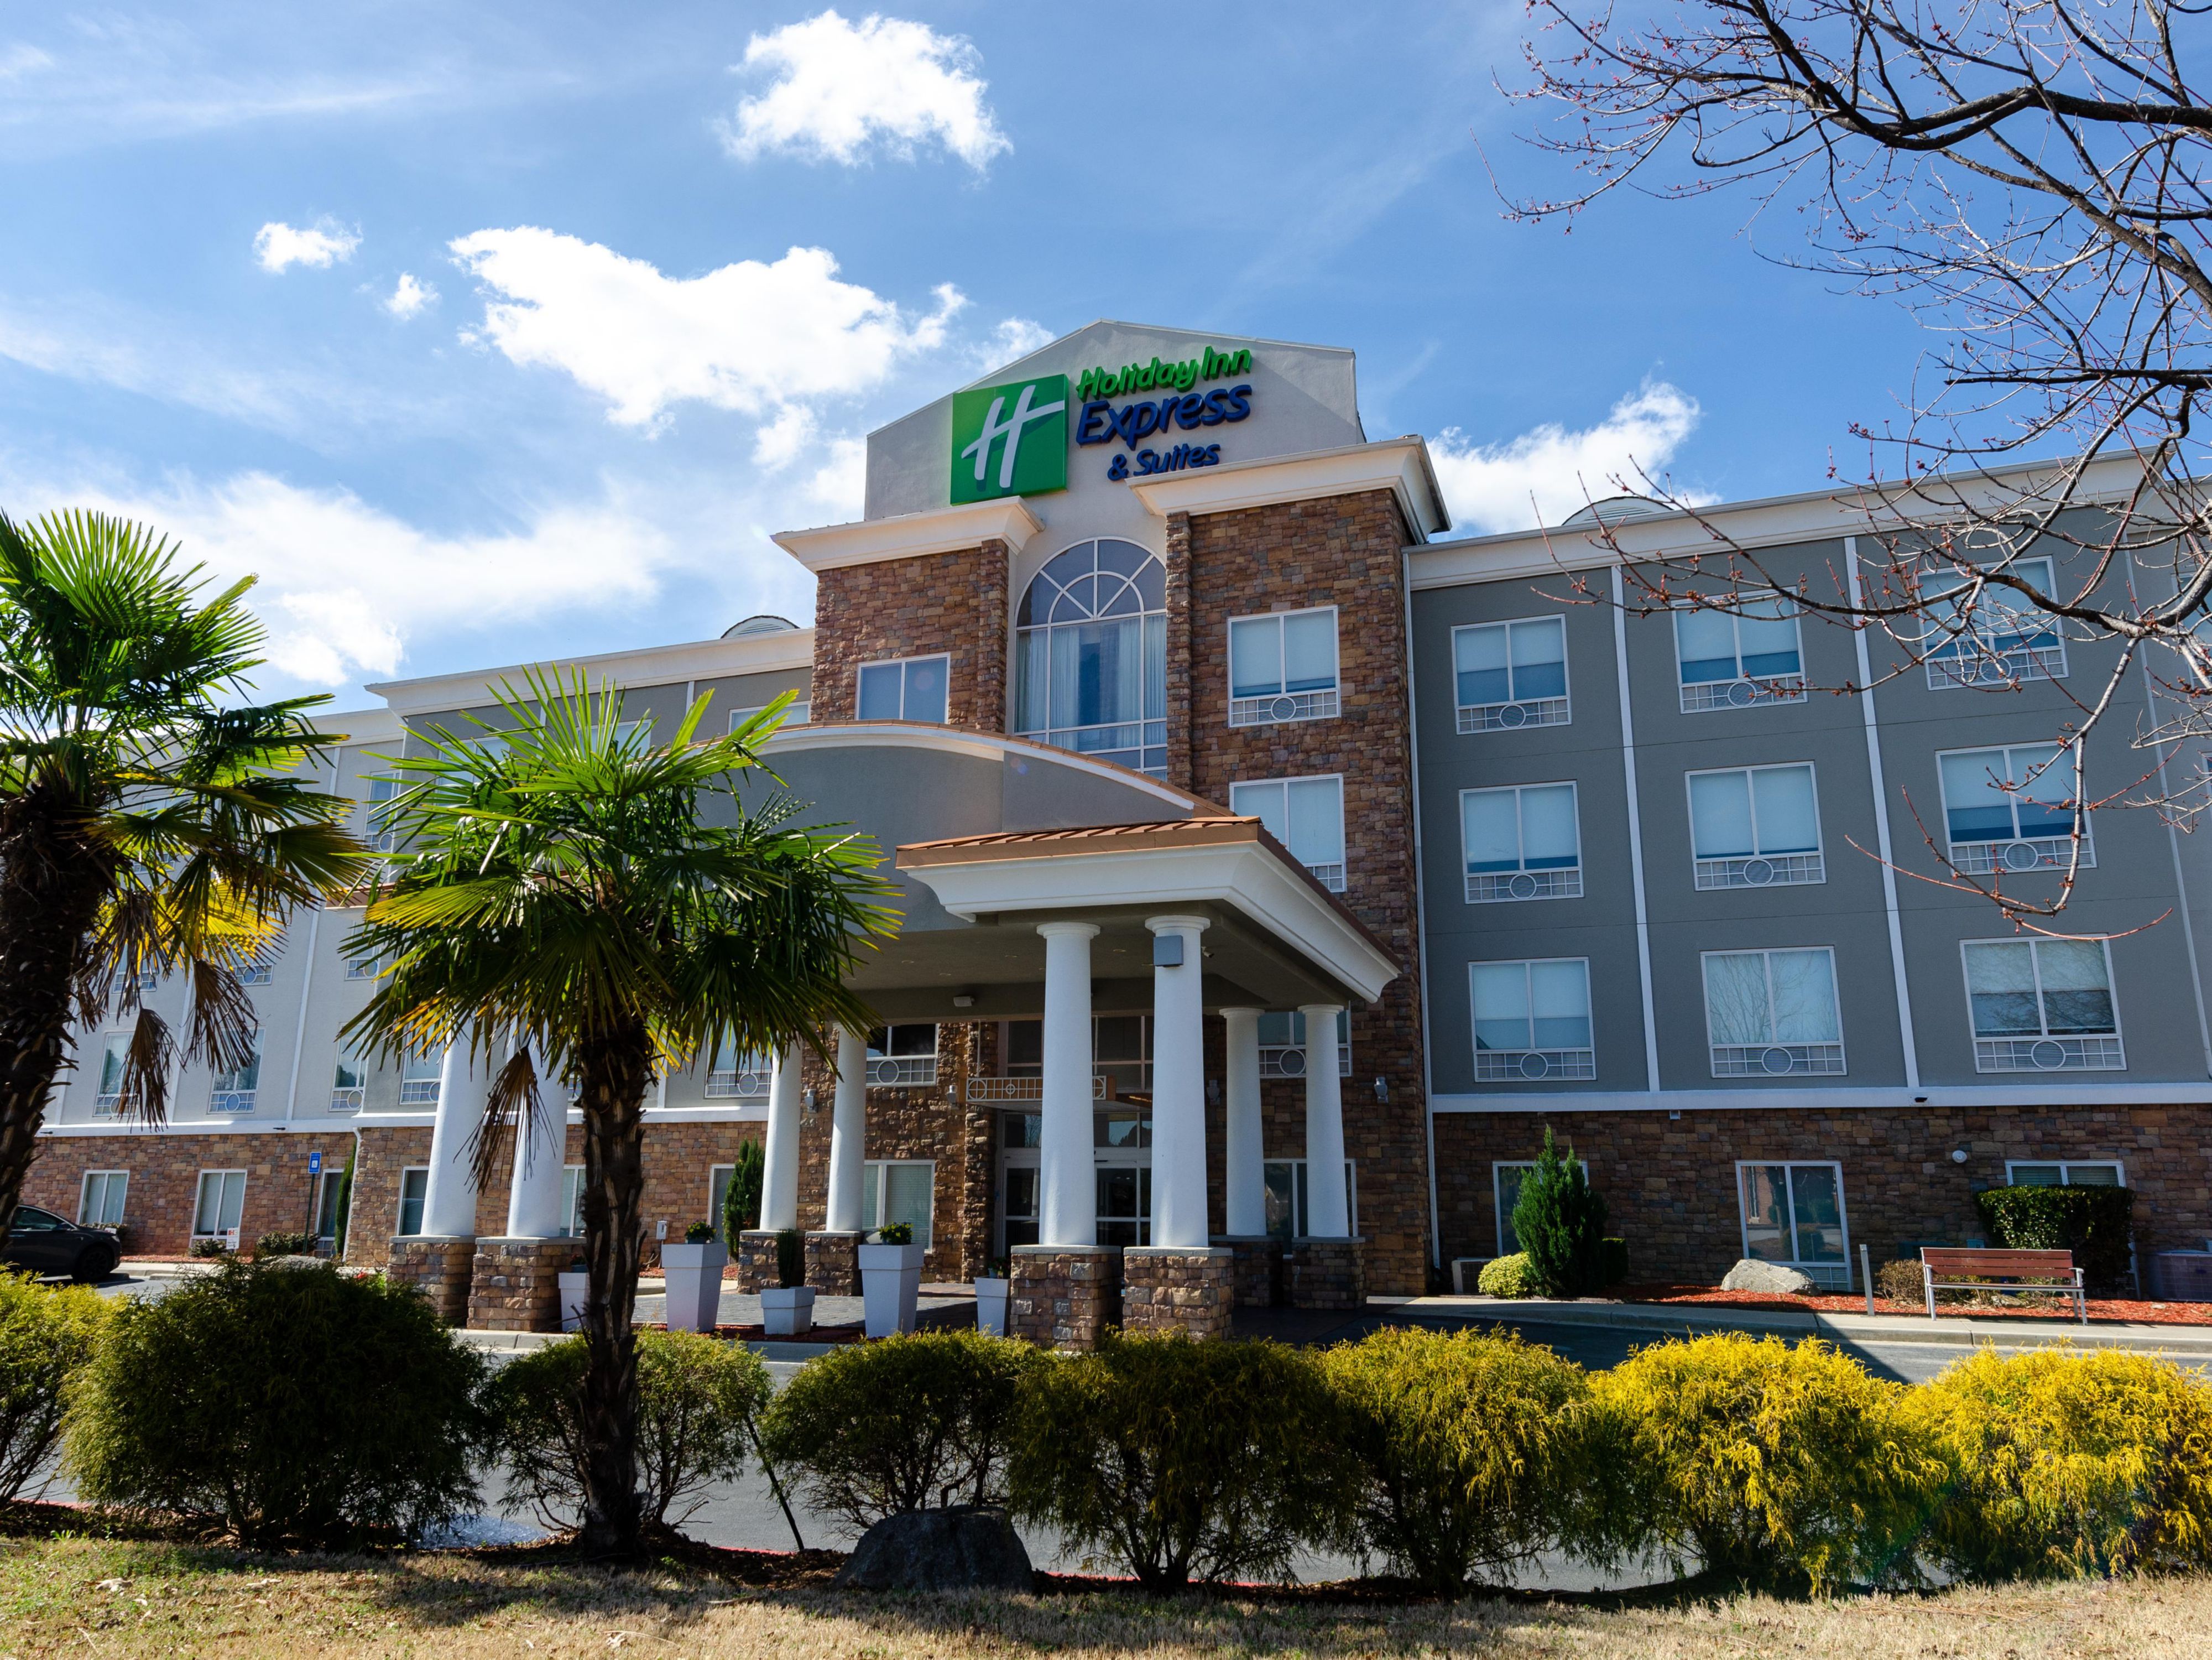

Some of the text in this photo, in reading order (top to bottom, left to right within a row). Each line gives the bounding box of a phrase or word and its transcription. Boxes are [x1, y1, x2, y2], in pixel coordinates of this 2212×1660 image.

[1076, 346, 1253, 402] Holiday Inn
[1076, 384, 1253, 451] Express
[1107, 444, 1221, 481] & Suites
